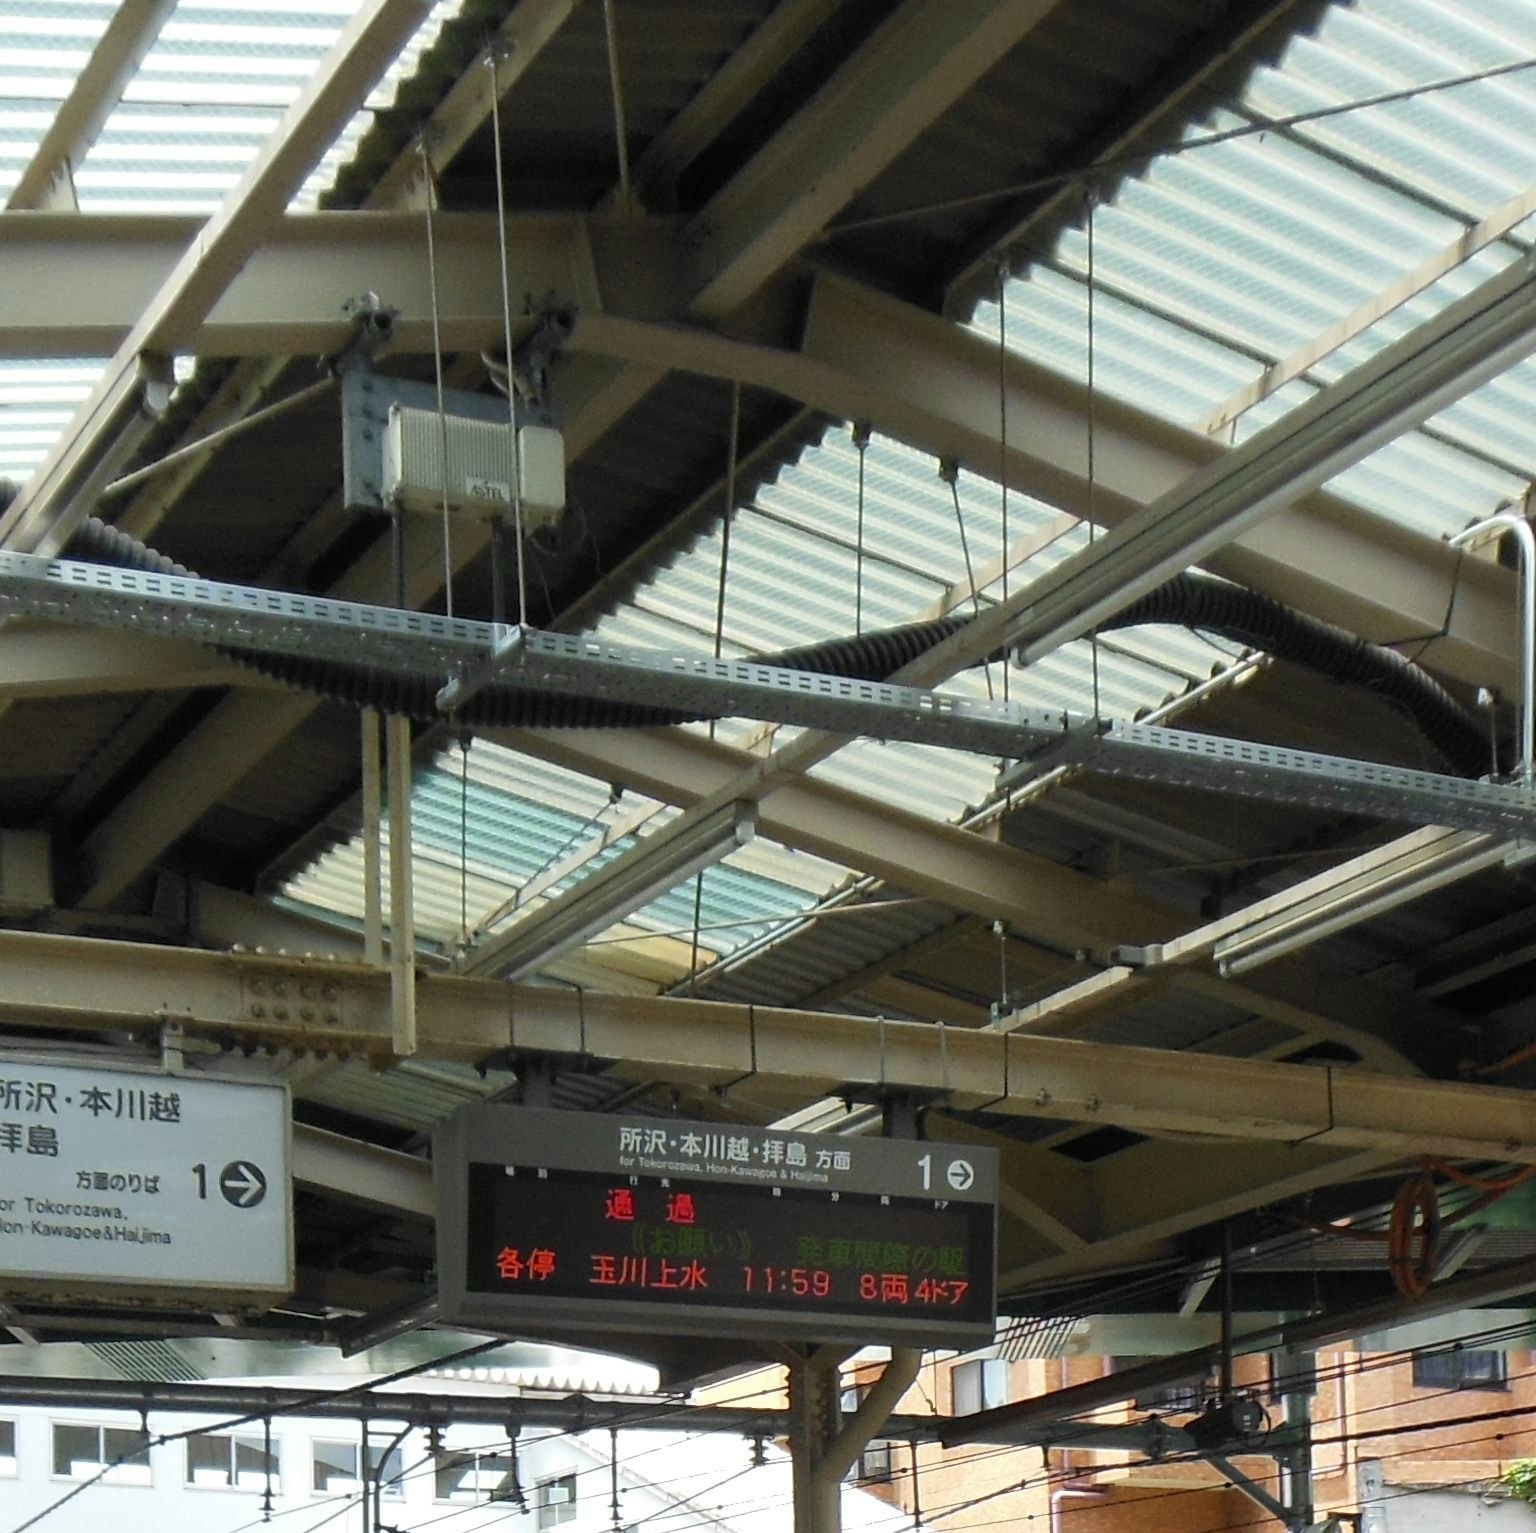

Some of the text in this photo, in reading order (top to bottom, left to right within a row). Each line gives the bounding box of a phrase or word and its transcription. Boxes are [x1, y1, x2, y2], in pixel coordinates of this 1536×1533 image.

[619, 1155, 635, 1167] for
[815, 1149, 851, 1171] 方面
[917, 1154, 931, 1190] 1
[76, 1170, 160, 1194] 方面のりば
[192, 1163, 207, 1200] 1
[497, 1246, 556, 1281] 各停
[589, 1254, 708, 1290] 玉川上水
[743, 1266, 831, 1297] 11:59
